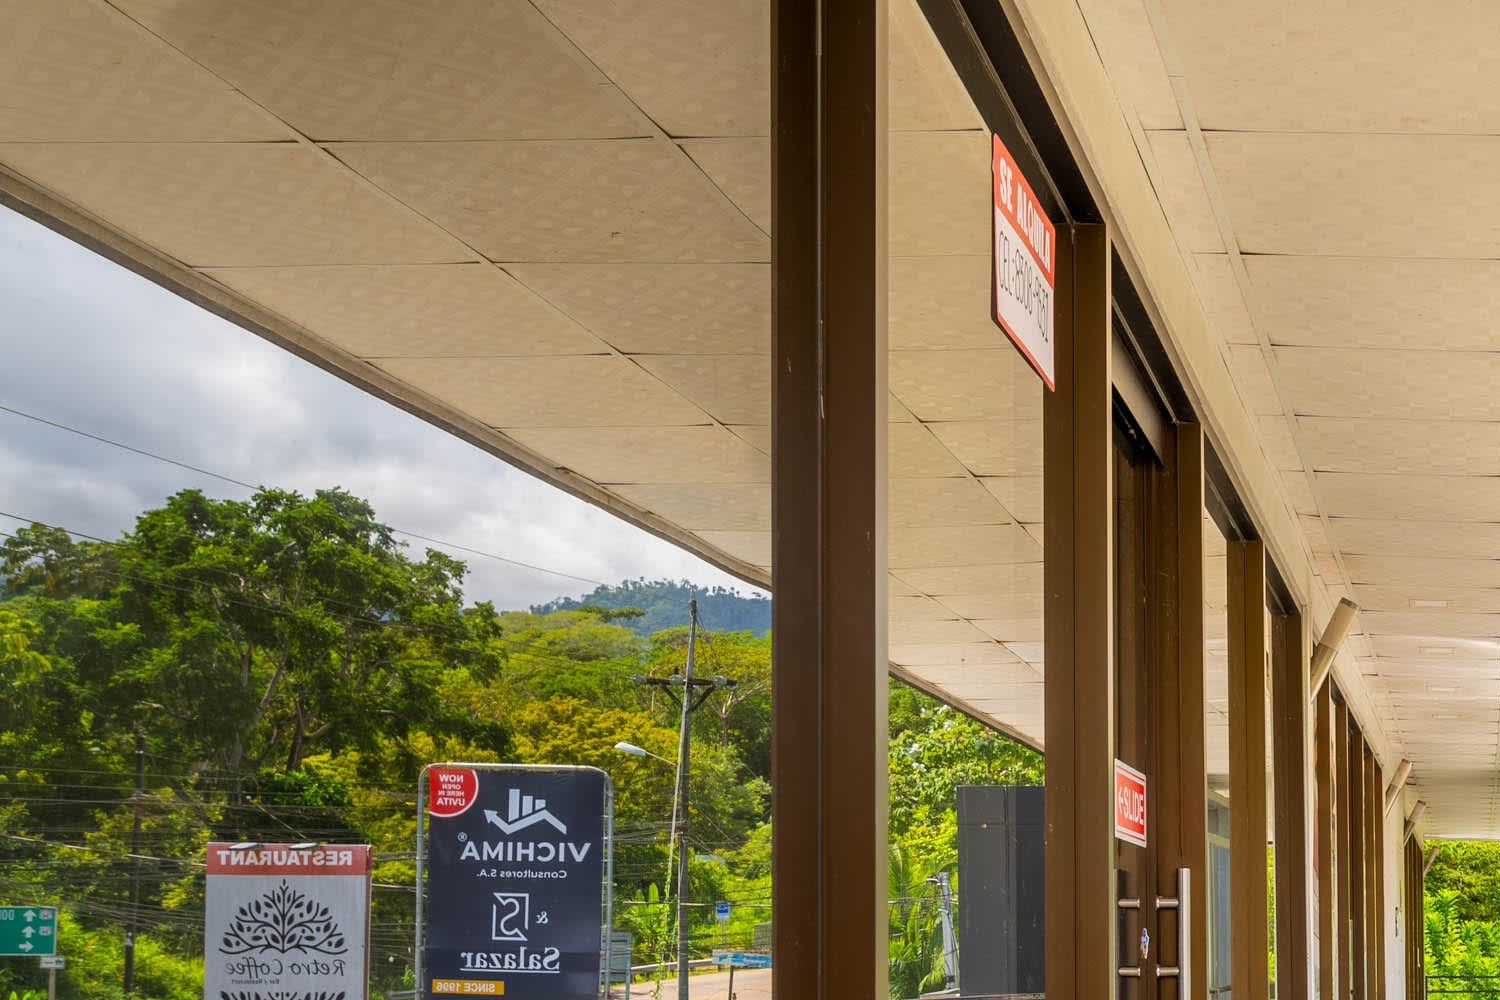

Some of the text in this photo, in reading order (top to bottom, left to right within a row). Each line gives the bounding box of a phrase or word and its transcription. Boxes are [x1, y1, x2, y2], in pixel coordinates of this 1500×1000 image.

[1000, 157, 1050, 274] SE ALQUILA
[1124, 786, 1144, 825] SLIDE
